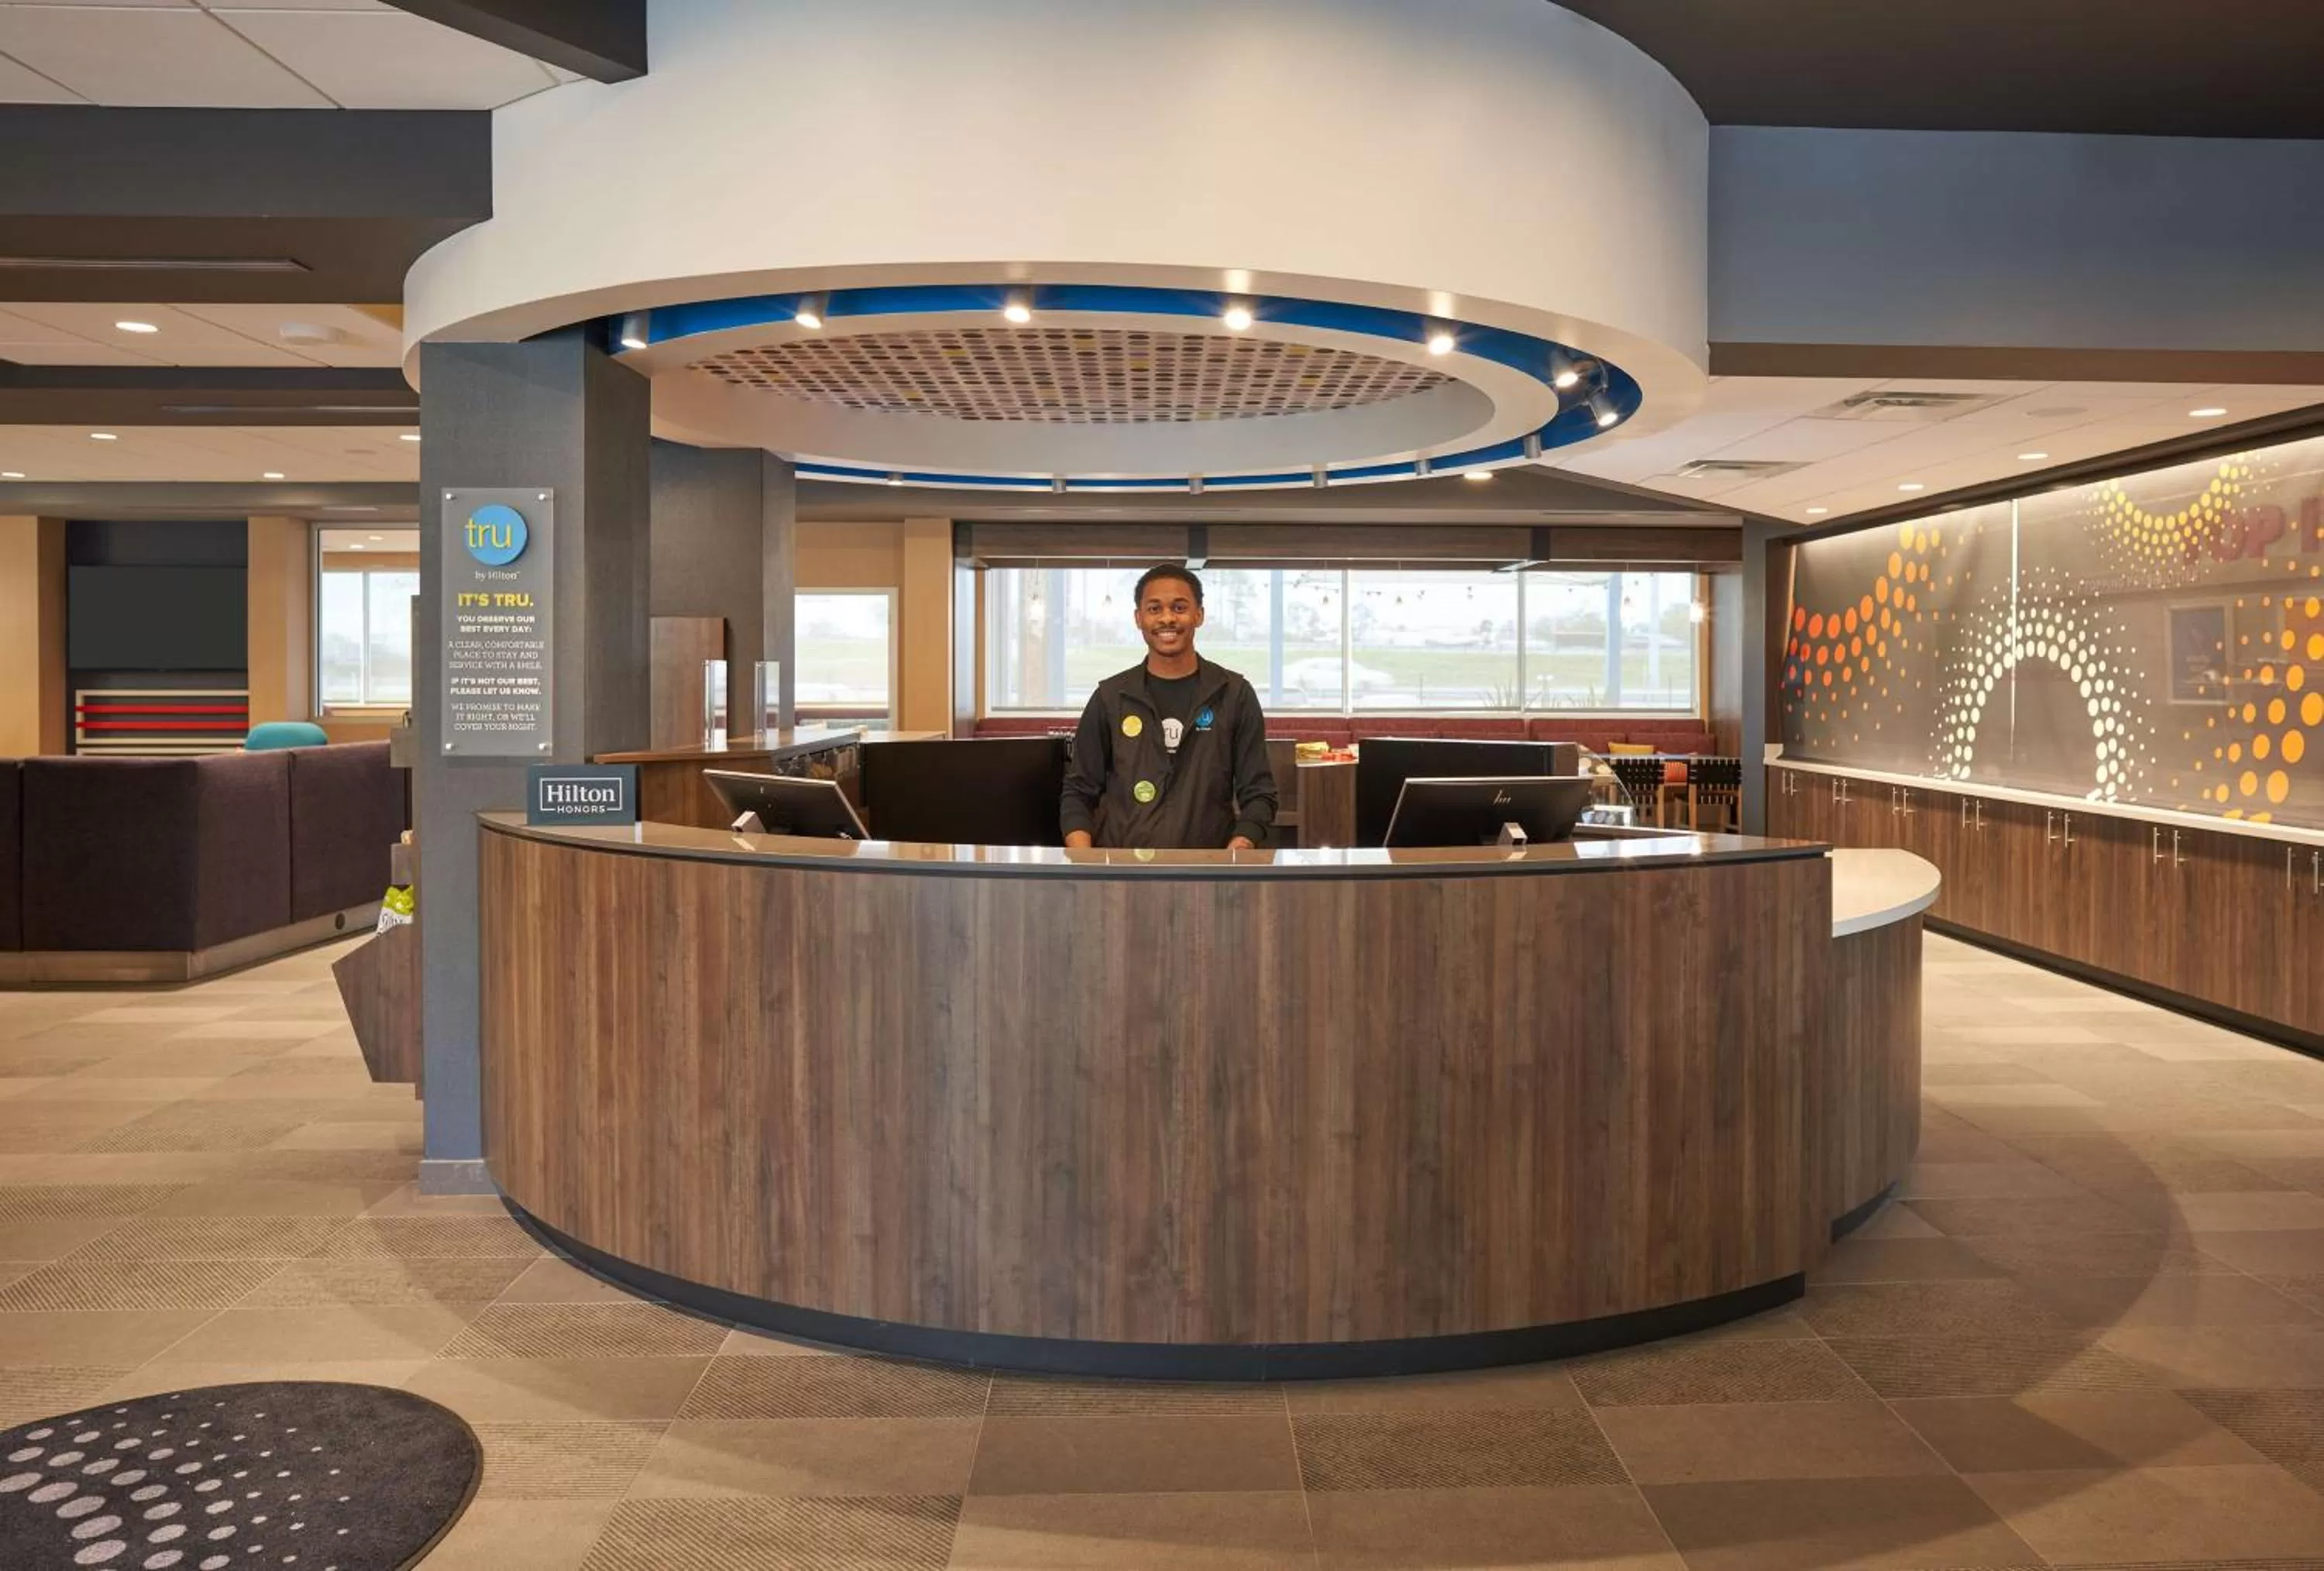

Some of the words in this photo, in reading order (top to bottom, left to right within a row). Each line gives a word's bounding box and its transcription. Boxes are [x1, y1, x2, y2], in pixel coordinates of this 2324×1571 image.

[465, 517, 512, 548] tru
[475, 571, 486, 582] by
[458, 593, 490, 607] IT'S
[494, 593, 535, 607] TRU.
[547, 784, 616, 803] Hilton
[557, 805, 606, 813] HONORS
